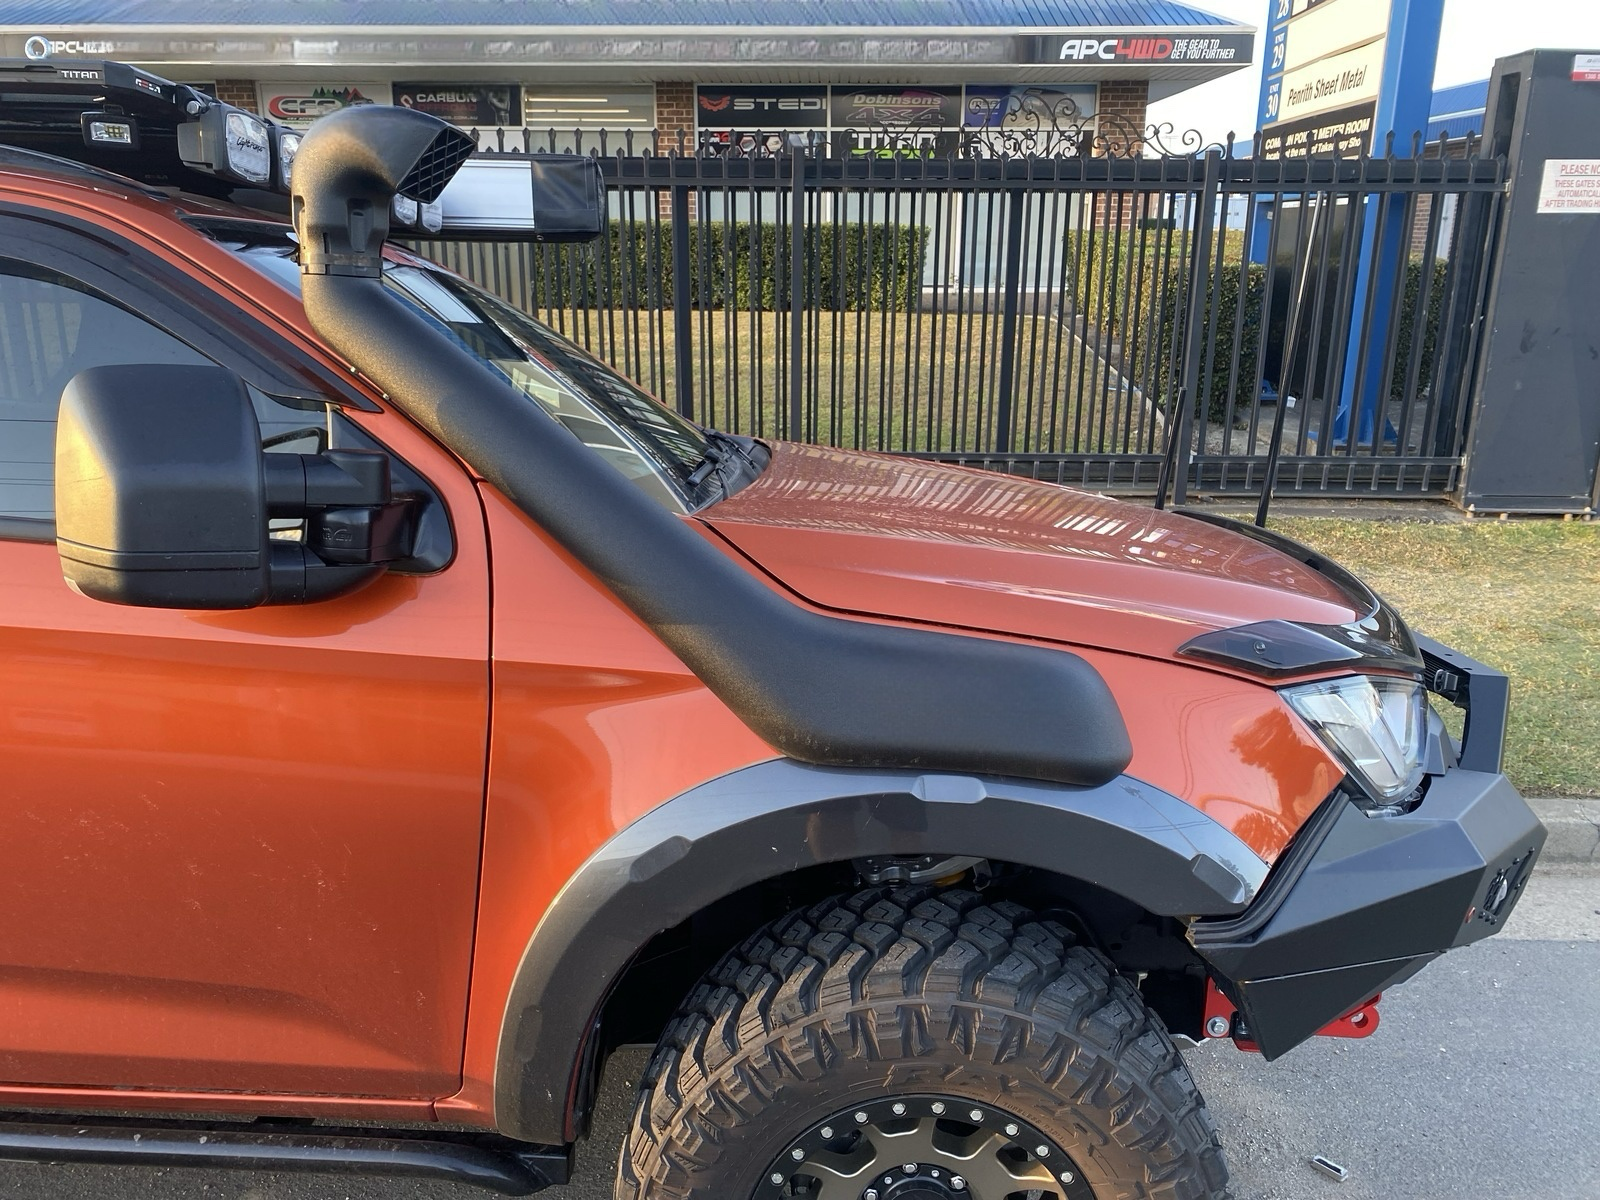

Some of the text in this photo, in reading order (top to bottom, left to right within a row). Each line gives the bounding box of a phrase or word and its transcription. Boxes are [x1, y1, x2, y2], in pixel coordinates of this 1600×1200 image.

[1060, 39, 1173, 60] APC4WD
[1174, 39, 1220, 49] THE GEAR TO
[1171, 49, 1235, 59] GET YOU FURTHER
[1271, 43, 1285, 69] 29
[61, 70, 99, 79] TITAN
[1287, 65, 1368, 107] Penrith Sheet Metal
[733, 98, 827, 110] STEDI
[852, 94, 941, 105] Dobinsons
[1265, 94, 1279, 118] 30
[1345, 118, 1371, 135] ROOM
[1560, 164, 1590, 174] PLEASE
[1555, 179, 1575, 188] THESE
[1575, 179, 1595, 188] GATES
[1544, 199, 1565, 208] AFTER
[1566, 199, 1593, 208] TRADING
